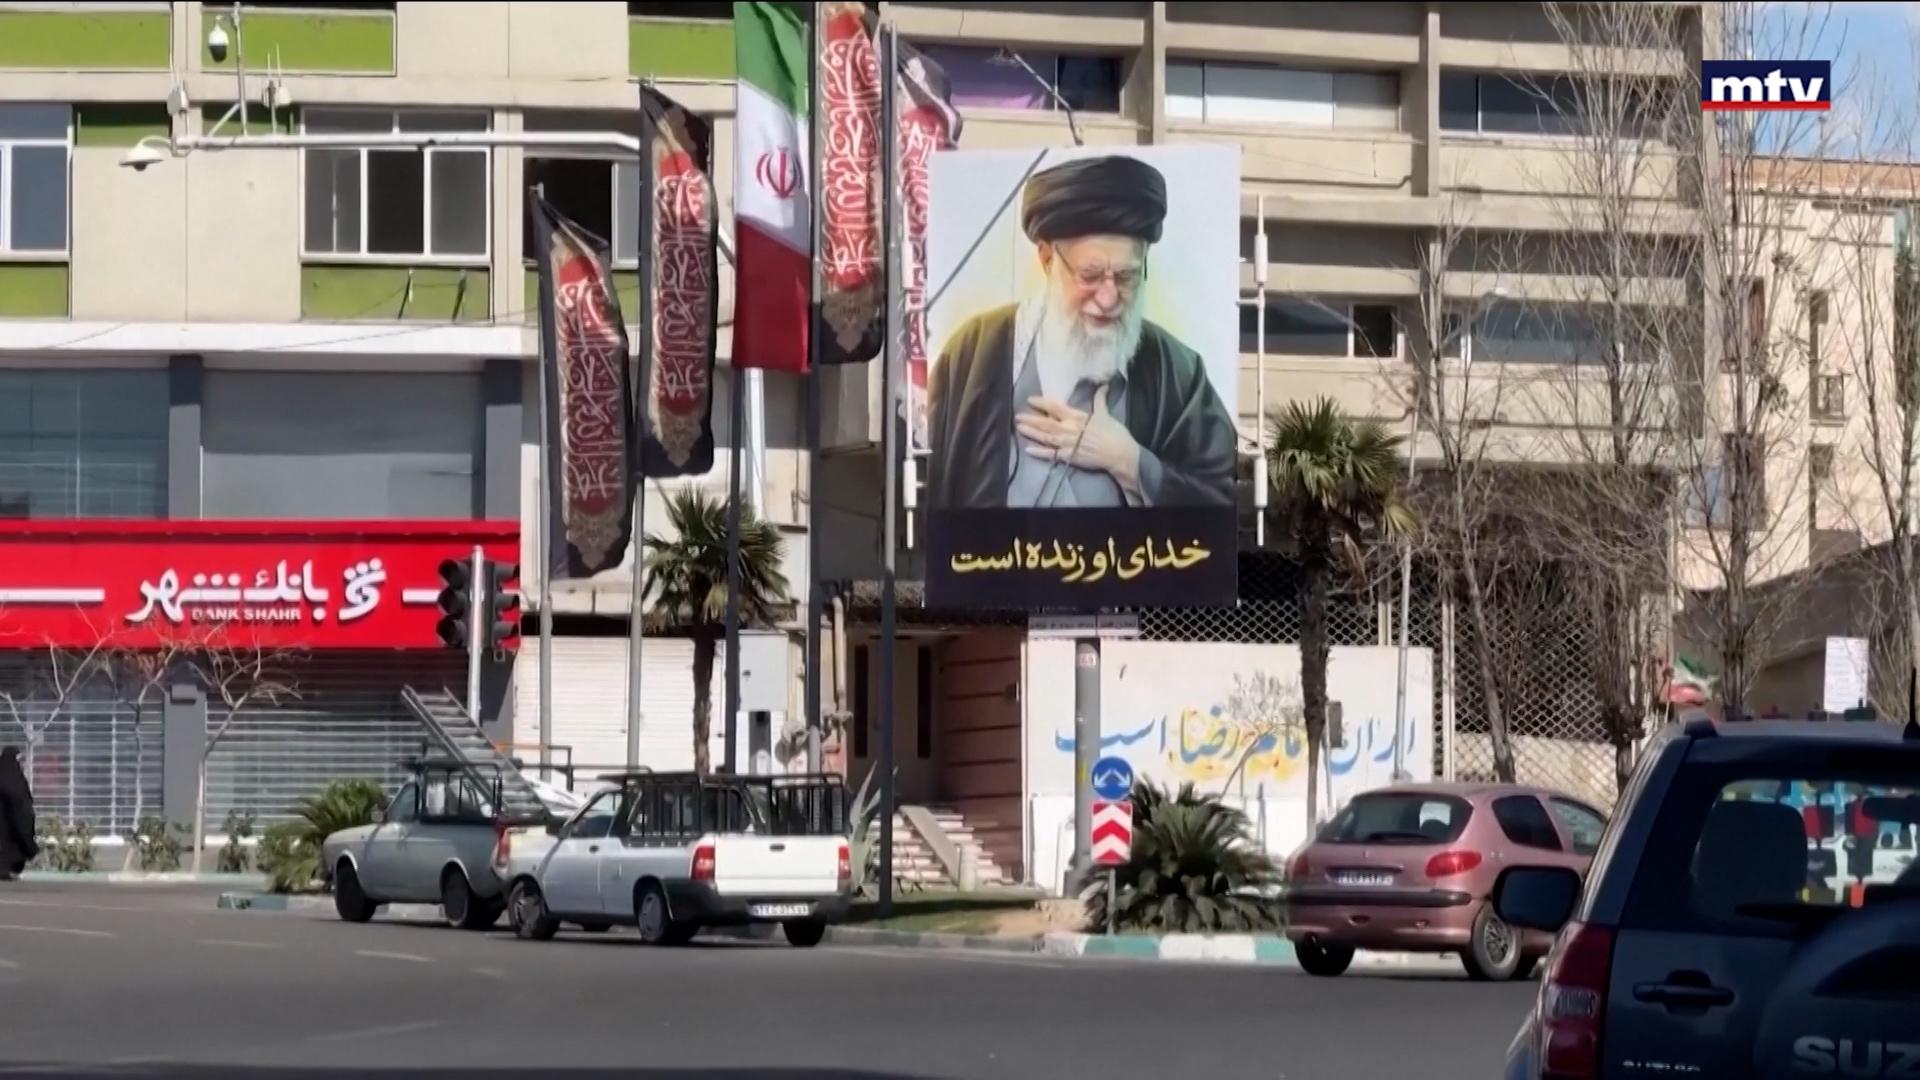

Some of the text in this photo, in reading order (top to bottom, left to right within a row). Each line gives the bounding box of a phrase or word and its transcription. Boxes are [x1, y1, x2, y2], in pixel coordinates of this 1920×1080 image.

[951, 536, 1211, 582] خدای او زنده است
[124, 568, 241, 622] شهر
[243, 607, 301, 620] SHAHR
